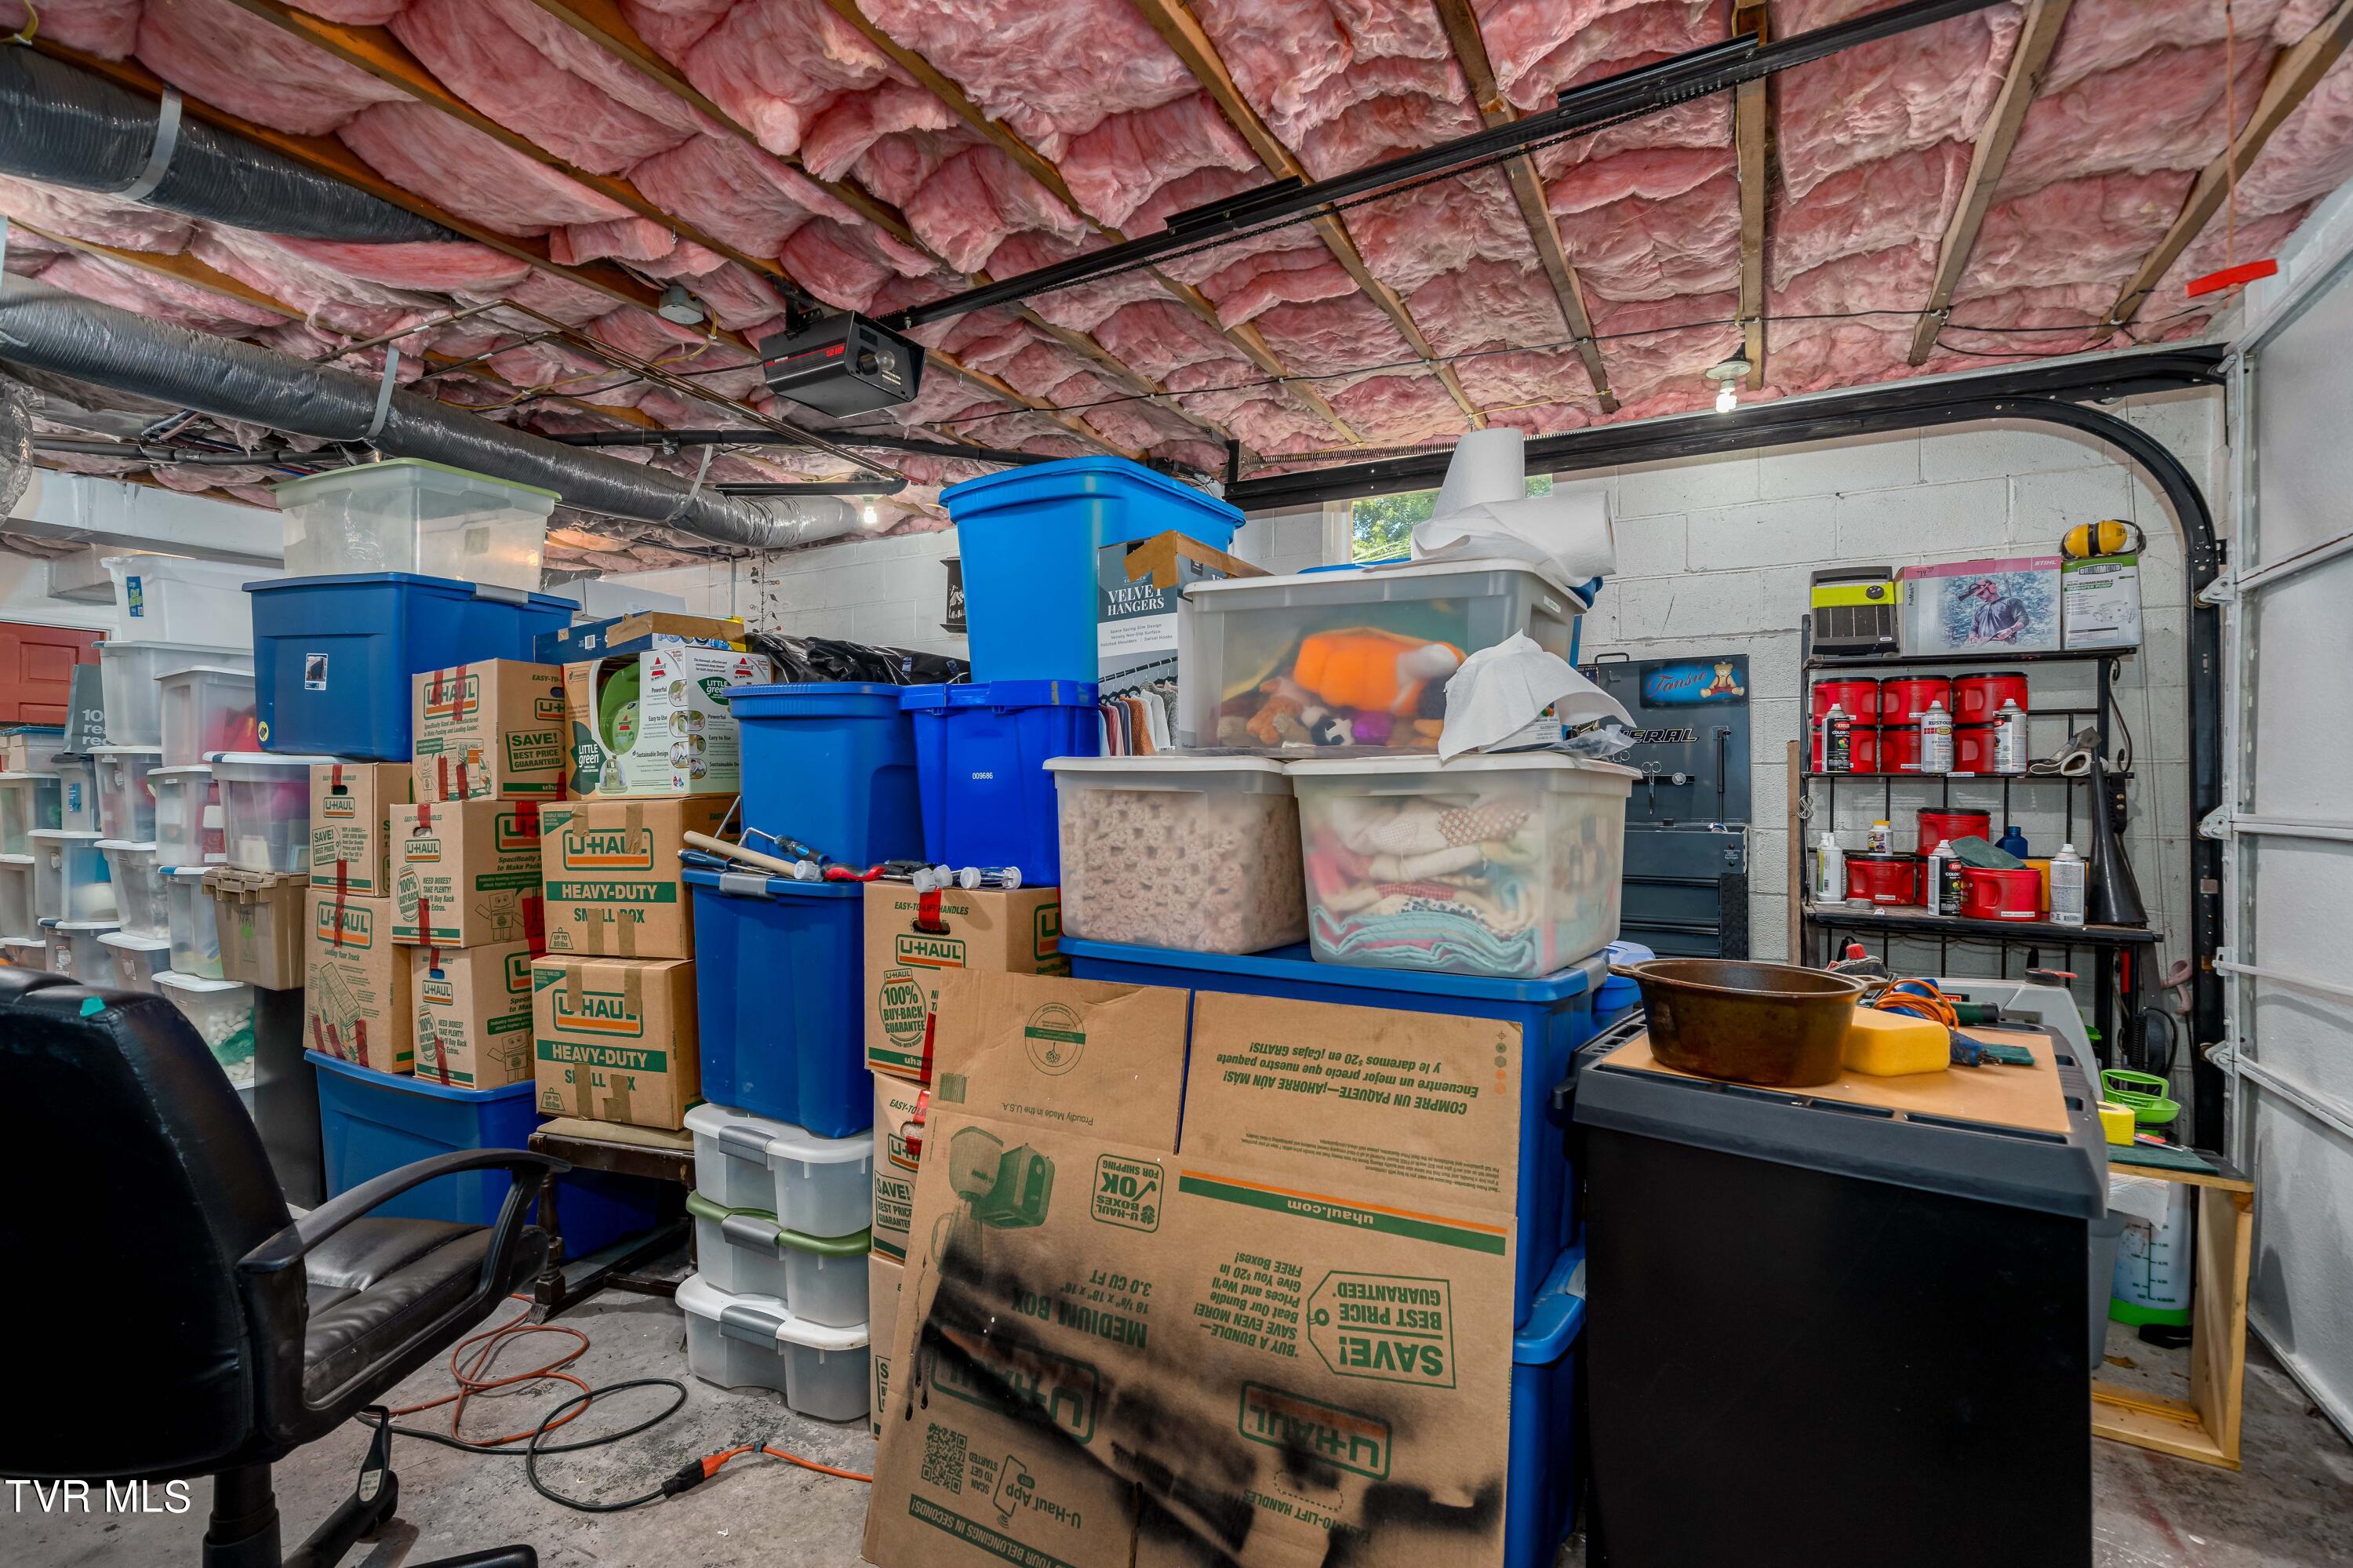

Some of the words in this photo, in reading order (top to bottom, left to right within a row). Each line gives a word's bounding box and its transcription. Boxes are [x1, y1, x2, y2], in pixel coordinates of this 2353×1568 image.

[2080, 565, 2120, 574] DRUMMOND
[1108, 584, 1162, 603] VELVET
[1107, 598, 1164, 616] HANGERS
[512, 733, 558, 747] SAVE!
[514, 750, 535, 760] BEST
[579, 744, 598, 754] LITTLE
[515, 759, 560, 768] GUARANTEED
[579, 753, 599, 767] green
[314, 829, 334, 842] SAVE!
[399, 876, 416, 893] 100%
[562, 884, 657, 900] HEAVY-DUTY
[900, 939, 961, 959] U-HAUL
[884, 985, 918, 1006] 100%
[883, 1006, 924, 1021] BUY-BACK
[885, 1020, 926, 1034] GUARANTEE
[552, 1044, 648, 1068] HEAVY-DUTY
[1249, 1042, 1289, 1057] GRATIS!
[1328, 1051, 1342, 1062] en
[1217, 1052, 1258, 1068] paquete
[1260, 1059, 1300, 1074] nuestro
[1366, 1055, 1417, 1072] daremos
[1431, 1062, 1442, 1072] y
[1302, 1062, 1323, 1075] que
[1324, 1065, 1362, 1081] precio
[1418, 1062, 1431, 1075] le
[1222, 1070, 1251, 1086] MÁS!
[1252, 1074, 1276, 1090] AÚN
[1362, 1070, 1398, 1087] mejor
[1398, 1077, 1415, 1089] un
[1417, 1079, 1479, 1098] Encuentre
[1393, 1093, 1412, 1108] UN
[1415, 1097, 1467, 1115] COMPRE
[1024, 1104, 1035, 1115] the
[1037, 1108, 1043, 1117] in
[1045, 1109, 1065, 1122] Made
[1065, 1111, 1093, 1126] Proudly
[1101, 1159, 1140, 1175] SHIPPING
[1142, 1167, 1159, 1180] FOR
[877, 1177, 911, 1200] SAVE!
[1100, 1172, 1137, 1199] OK
[878, 1201, 891, 1213] BEST
[1096, 1195, 1140, 1211] BOXES
[1095, 1203, 1139, 1221] U-HAUL
[1287, 1200, 1374, 1225] uhaul.com
[1219, 1263, 1231, 1276] in
[1233, 1252, 1272, 1271] Boxes!
[1089, 1270, 1107, 1286] FT
[1273, 1261, 1304, 1279] FREE
[1108, 1274, 1127, 1291] CU
[1211, 1276, 1238, 1293] We'll
[1253, 1271, 1274, 1287] You
[1276, 1276, 1302, 1293] Give
[1129, 1279, 1152, 1297] 3.0
[1240, 1284, 1263, 1299] and
[1010, 1289, 1051, 1322] BOX
[1107, 1293, 1115, 1304] x
[1209, 1291, 1248, 1312] Bundle
[1264, 1290, 1300, 1309] Prices
[1136, 1301, 1149, 1315] 18
[1193, 1302, 1231, 1324] MORE!
[1249, 1302, 1271, 1317] Our
[1338, 1302, 1391, 1326] PRICE
[1232, 1313, 1264, 1333] EVEN
[1272, 1308, 1300, 1325] Beat
[1395, 1308, 1442, 1331] BEST
[1057, 1301, 1147, 1350] MEDIUM
[1267, 1321, 1298, 1341] SAVE
[1259, 1337, 1269, 1350] A
[1338, 1336, 1444, 1377] SAVE!
[969, 1451, 998, 1472] STARTED
[969, 1465, 983, 1477] GET
[984, 1471, 994, 1483] TO
[971, 1480, 990, 1494] SCAN
[1006, 1484, 1032, 1508] App
[1242, 1489, 1293, 1516] HANDLES
[911, 1498, 954, 1530] SECONDS!
[1035, 1497, 1082, 1530] U-Haul
[955, 1521, 966, 1534] IN
[966, 1525, 1024, 1559] BELONGINGS
